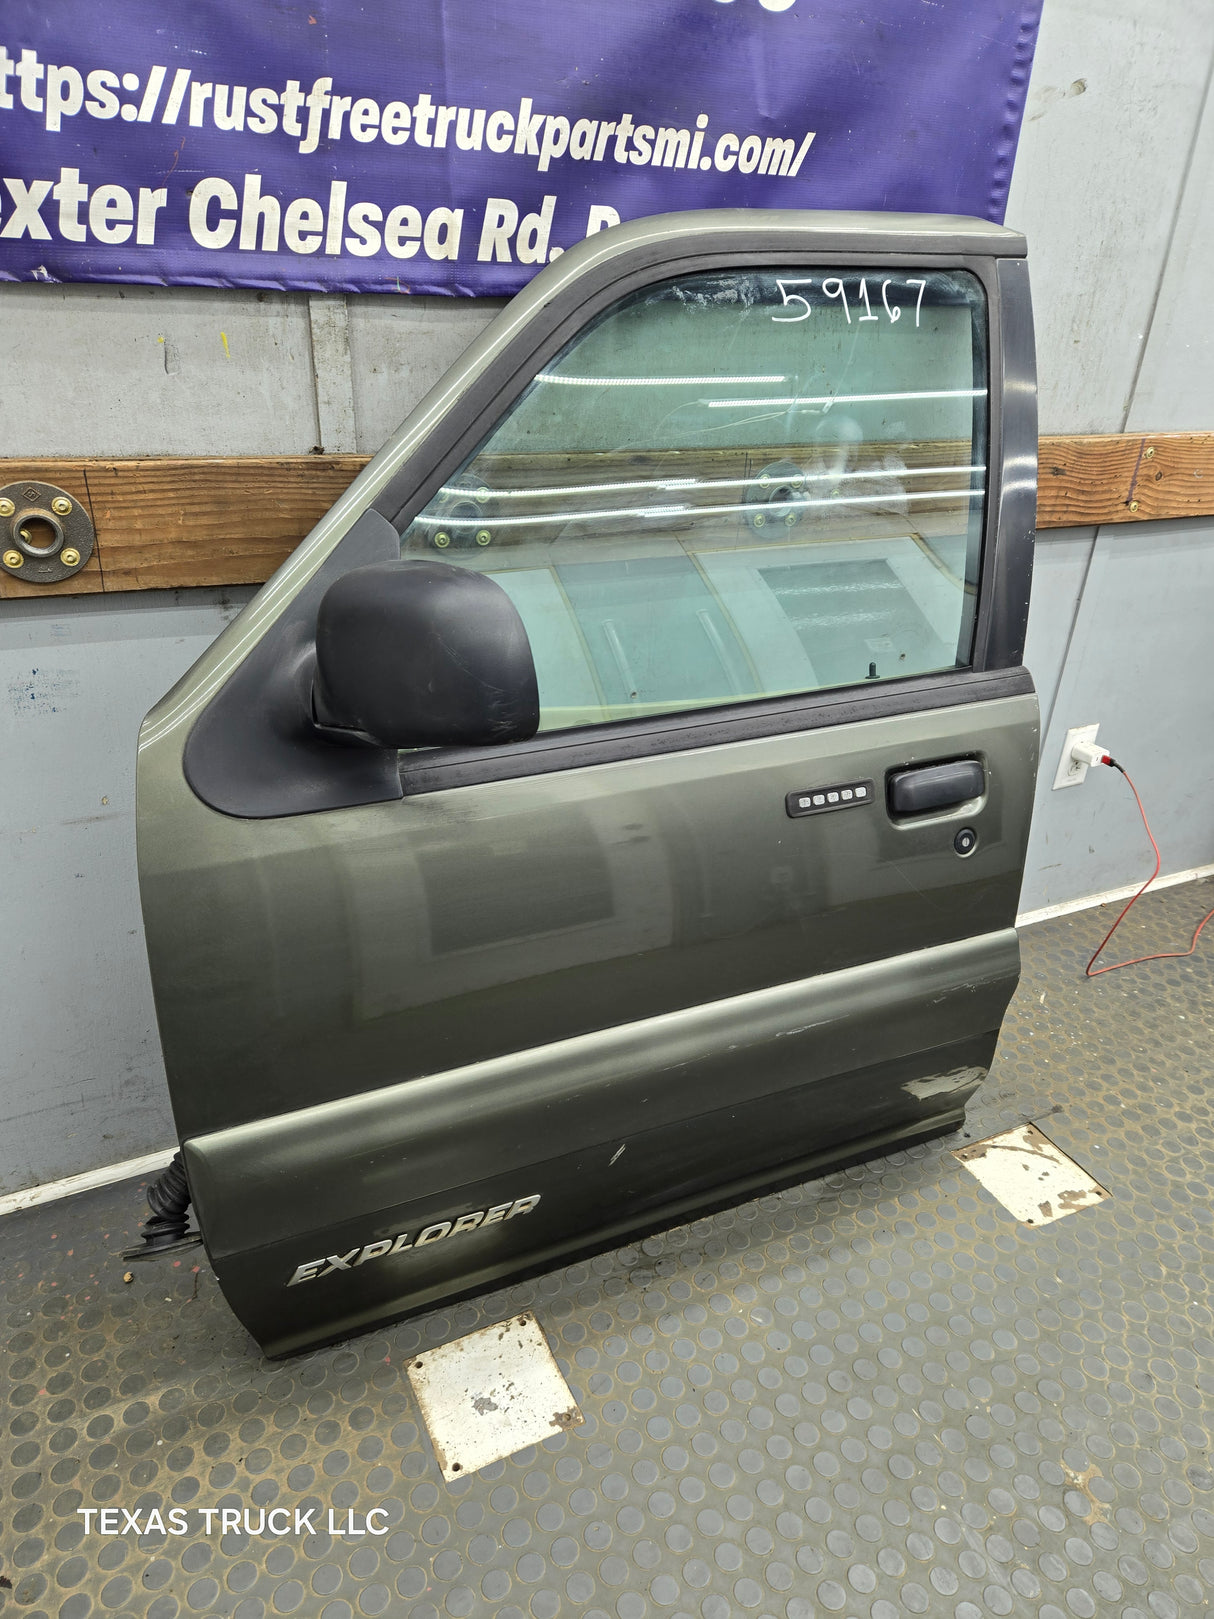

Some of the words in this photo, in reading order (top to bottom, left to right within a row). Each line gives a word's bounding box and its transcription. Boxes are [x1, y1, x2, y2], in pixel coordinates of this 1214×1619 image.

[0, 167, 168, 245] xter
[188, 174, 465, 260] Chelsea
[477, 195, 565, 264] Rd.
[771, 277, 927, 328] 59167
[286, 1194, 542, 1287] EXPLORER
